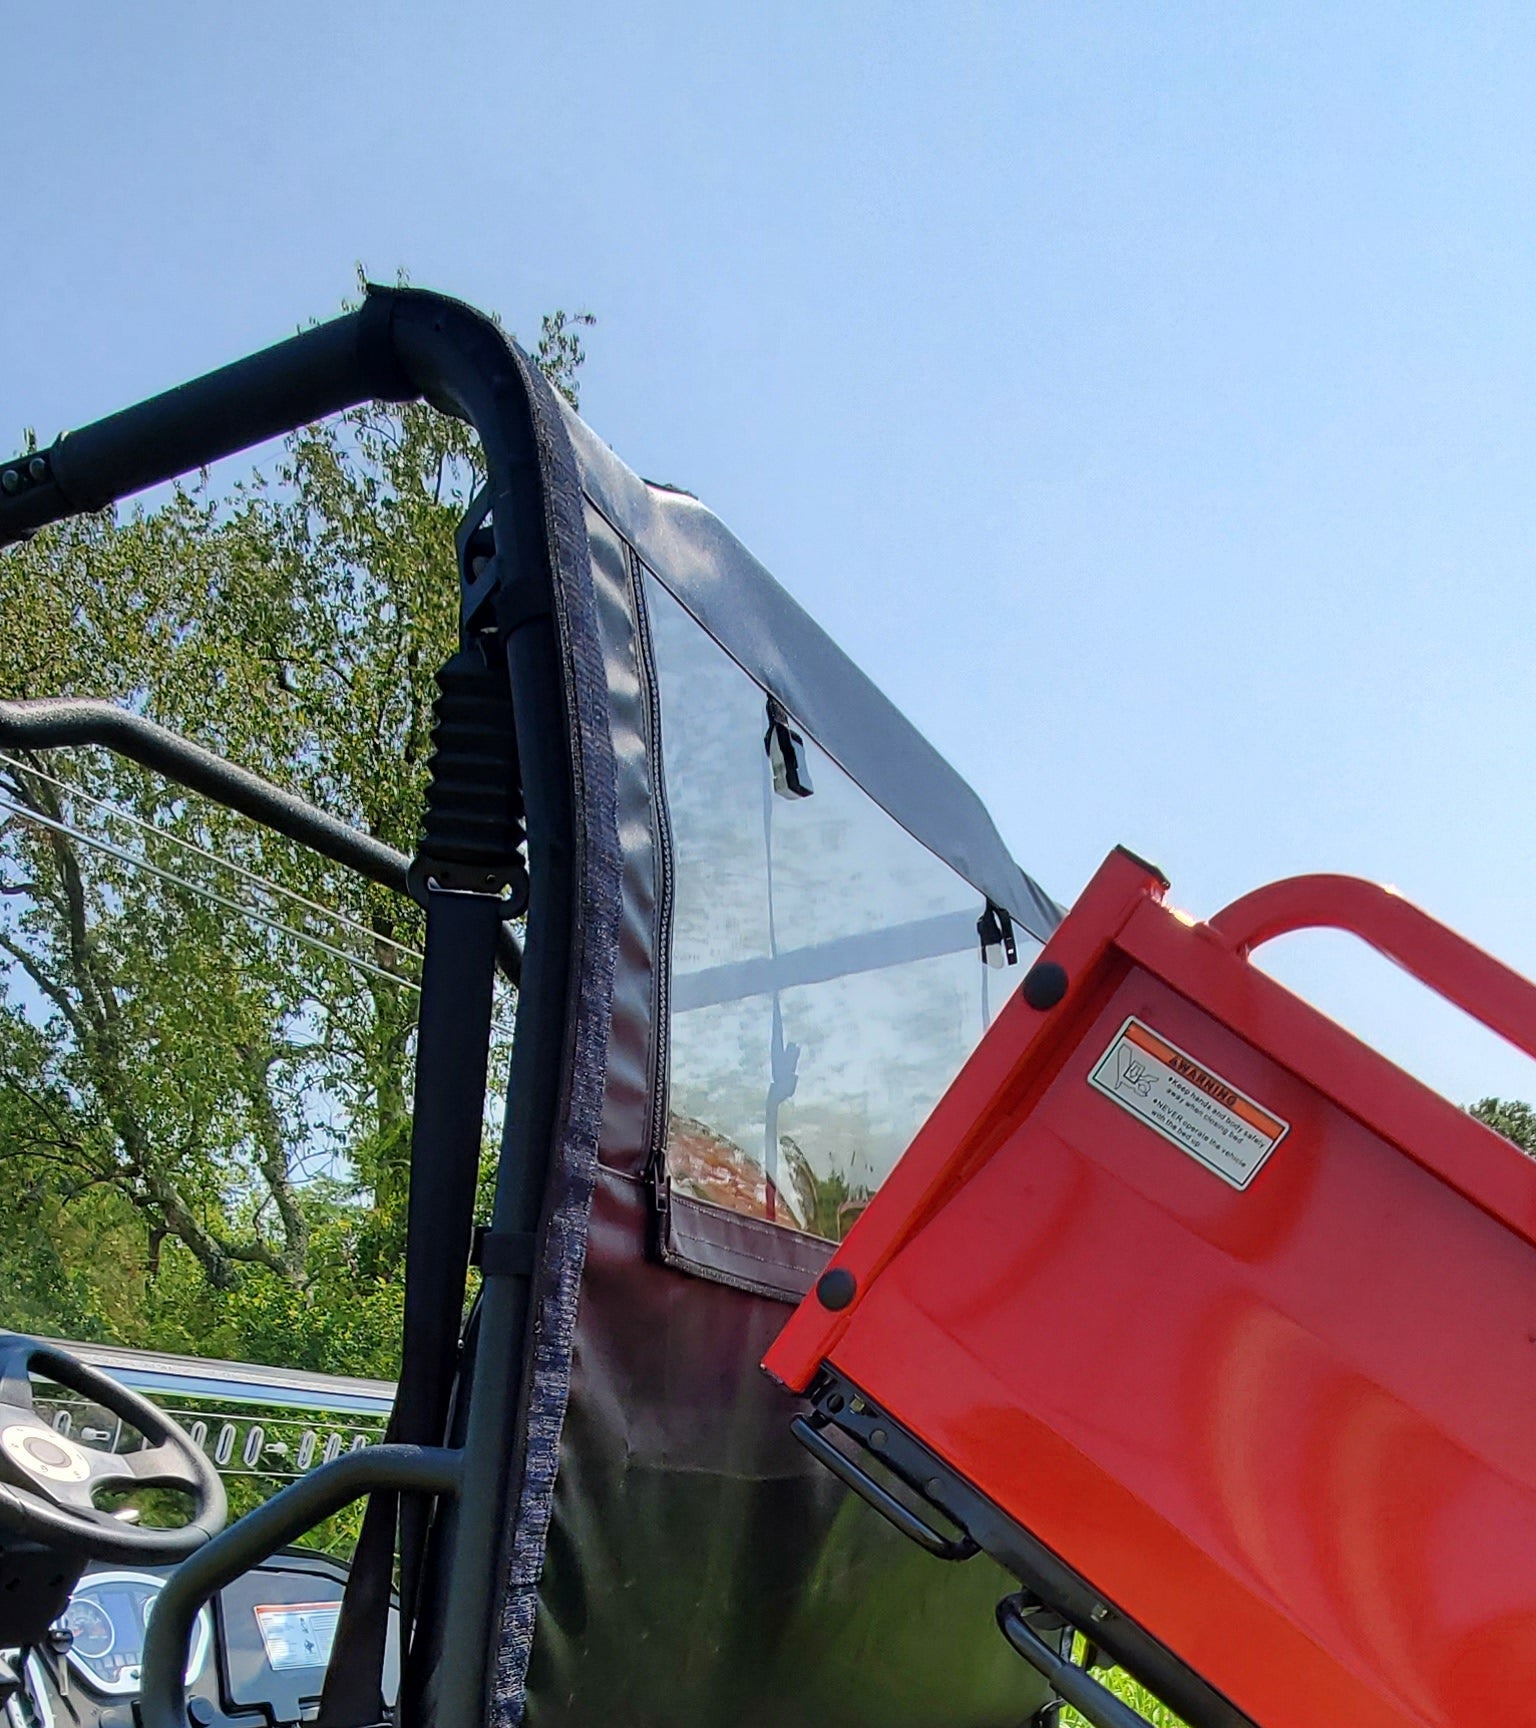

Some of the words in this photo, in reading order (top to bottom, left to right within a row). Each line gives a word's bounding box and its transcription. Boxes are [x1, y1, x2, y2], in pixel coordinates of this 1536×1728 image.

[1172, 1079, 1190, 1095] Keep
[1190, 1092, 1212, 1110] hands
[1212, 1108, 1227, 1121] and
[1226, 1117, 1243, 1133] body
[1177, 1056, 1237, 1107] WARNING
[1151, 1109, 1166, 1121] with
[1166, 1119, 1178, 1130] the
[1177, 1127, 1192, 1140] bed
[1191, 1138, 1201, 1148] up
[1156, 1101, 1183, 1122] NEVER
[1183, 1120, 1209, 1141] operate
[1209, 1139, 1221, 1150] the
[1222, 1148, 1247, 1168] vehicle
[1167, 1088, 1184, 1103] away
[1185, 1101, 1203, 1117] when
[1204, 1114, 1228, 1135] closing
[1228, 1131, 1244, 1144] bed
